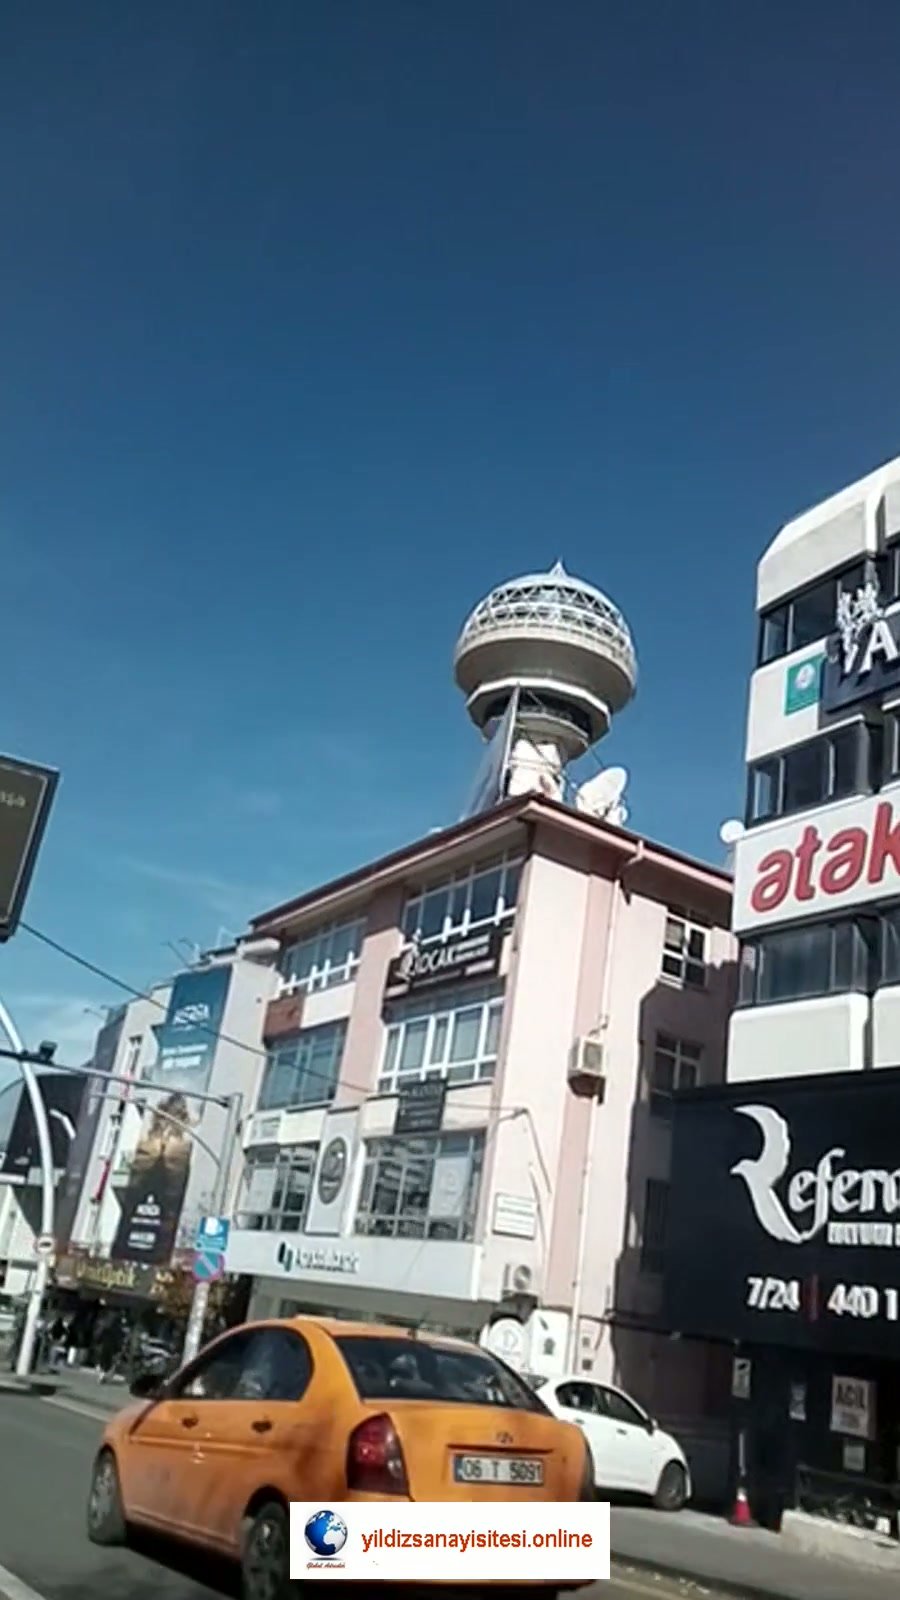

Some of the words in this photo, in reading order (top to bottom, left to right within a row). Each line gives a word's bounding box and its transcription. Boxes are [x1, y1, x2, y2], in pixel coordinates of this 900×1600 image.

[747, 1277, 800, 1311] 7/24
[463, 1459, 482, 1478] 06
[492, 1460, 500, 1478] T
